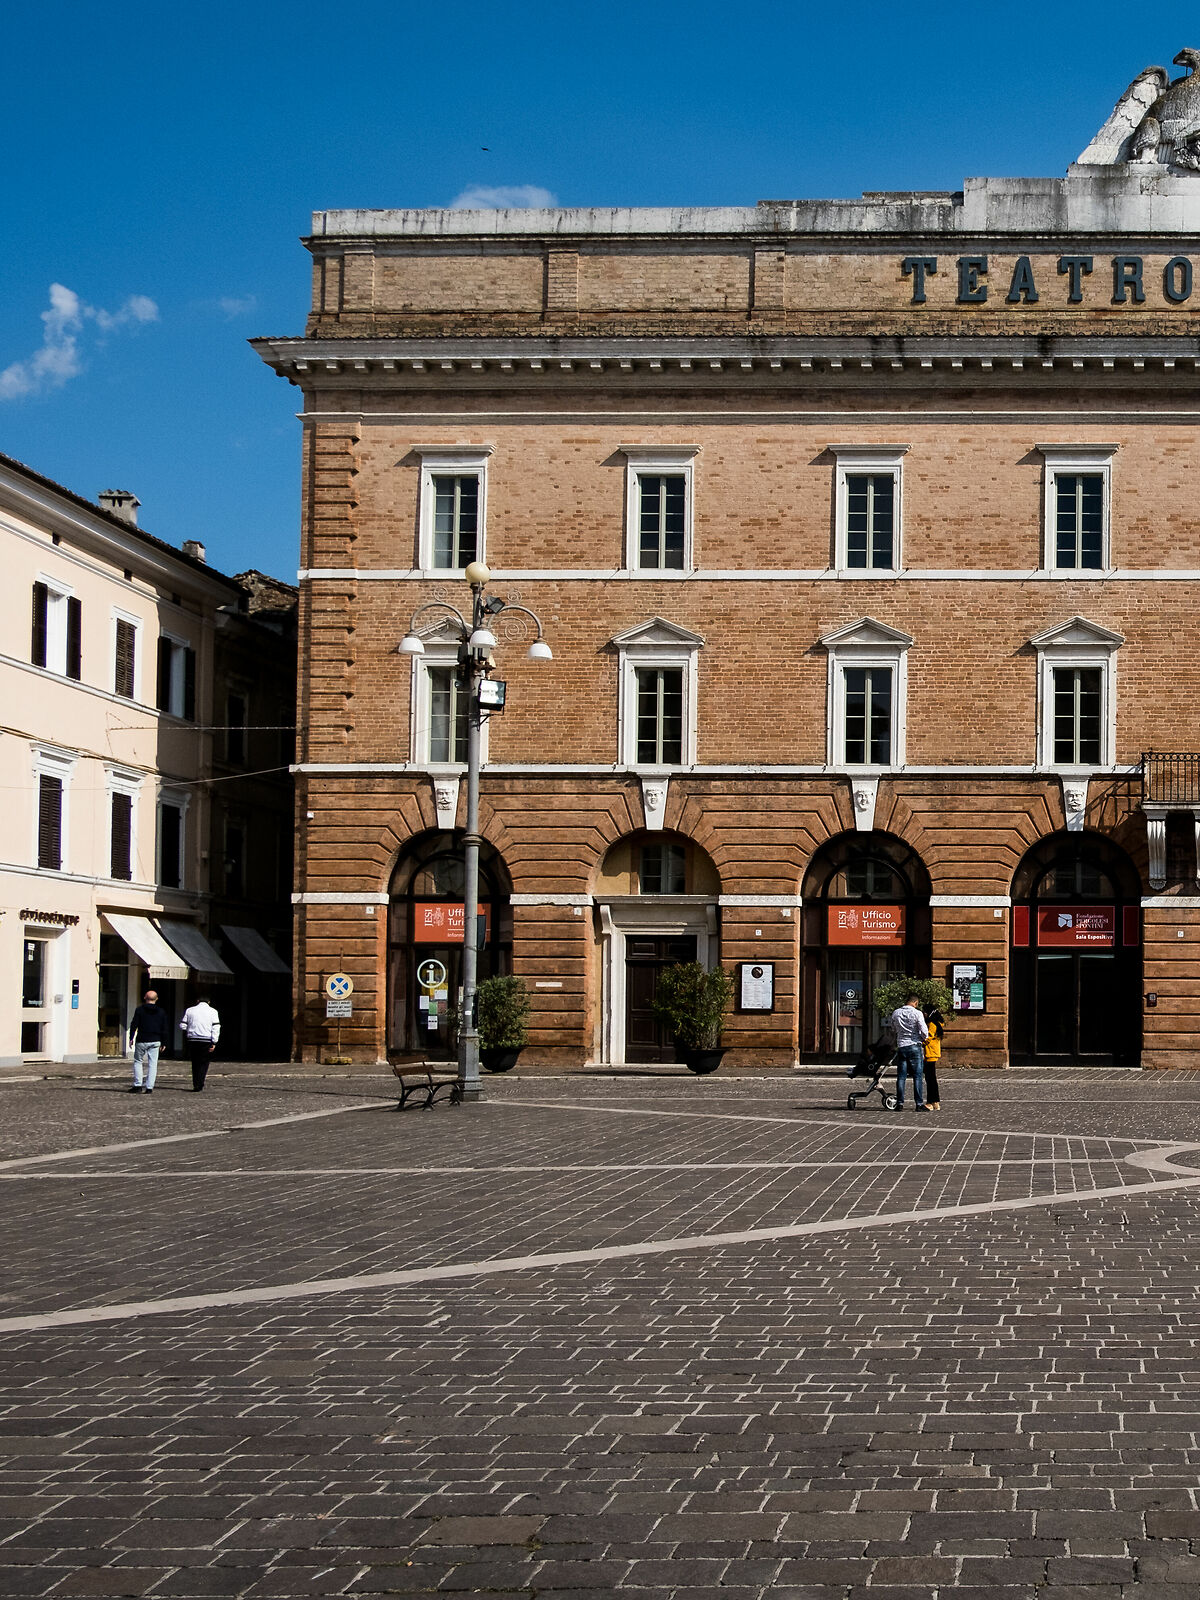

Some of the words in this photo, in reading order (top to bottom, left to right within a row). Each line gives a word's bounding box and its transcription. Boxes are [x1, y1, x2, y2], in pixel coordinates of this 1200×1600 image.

[903, 256, 1193, 303] TEATRO
[448, 908, 465, 917] Uffi
[862, 911, 892, 919] Ufficio
[424, 909, 433, 926] JESI
[448, 918, 465, 926] Turi
[838, 911, 848, 929] JESI
[862, 920, 896, 928] Turismo
